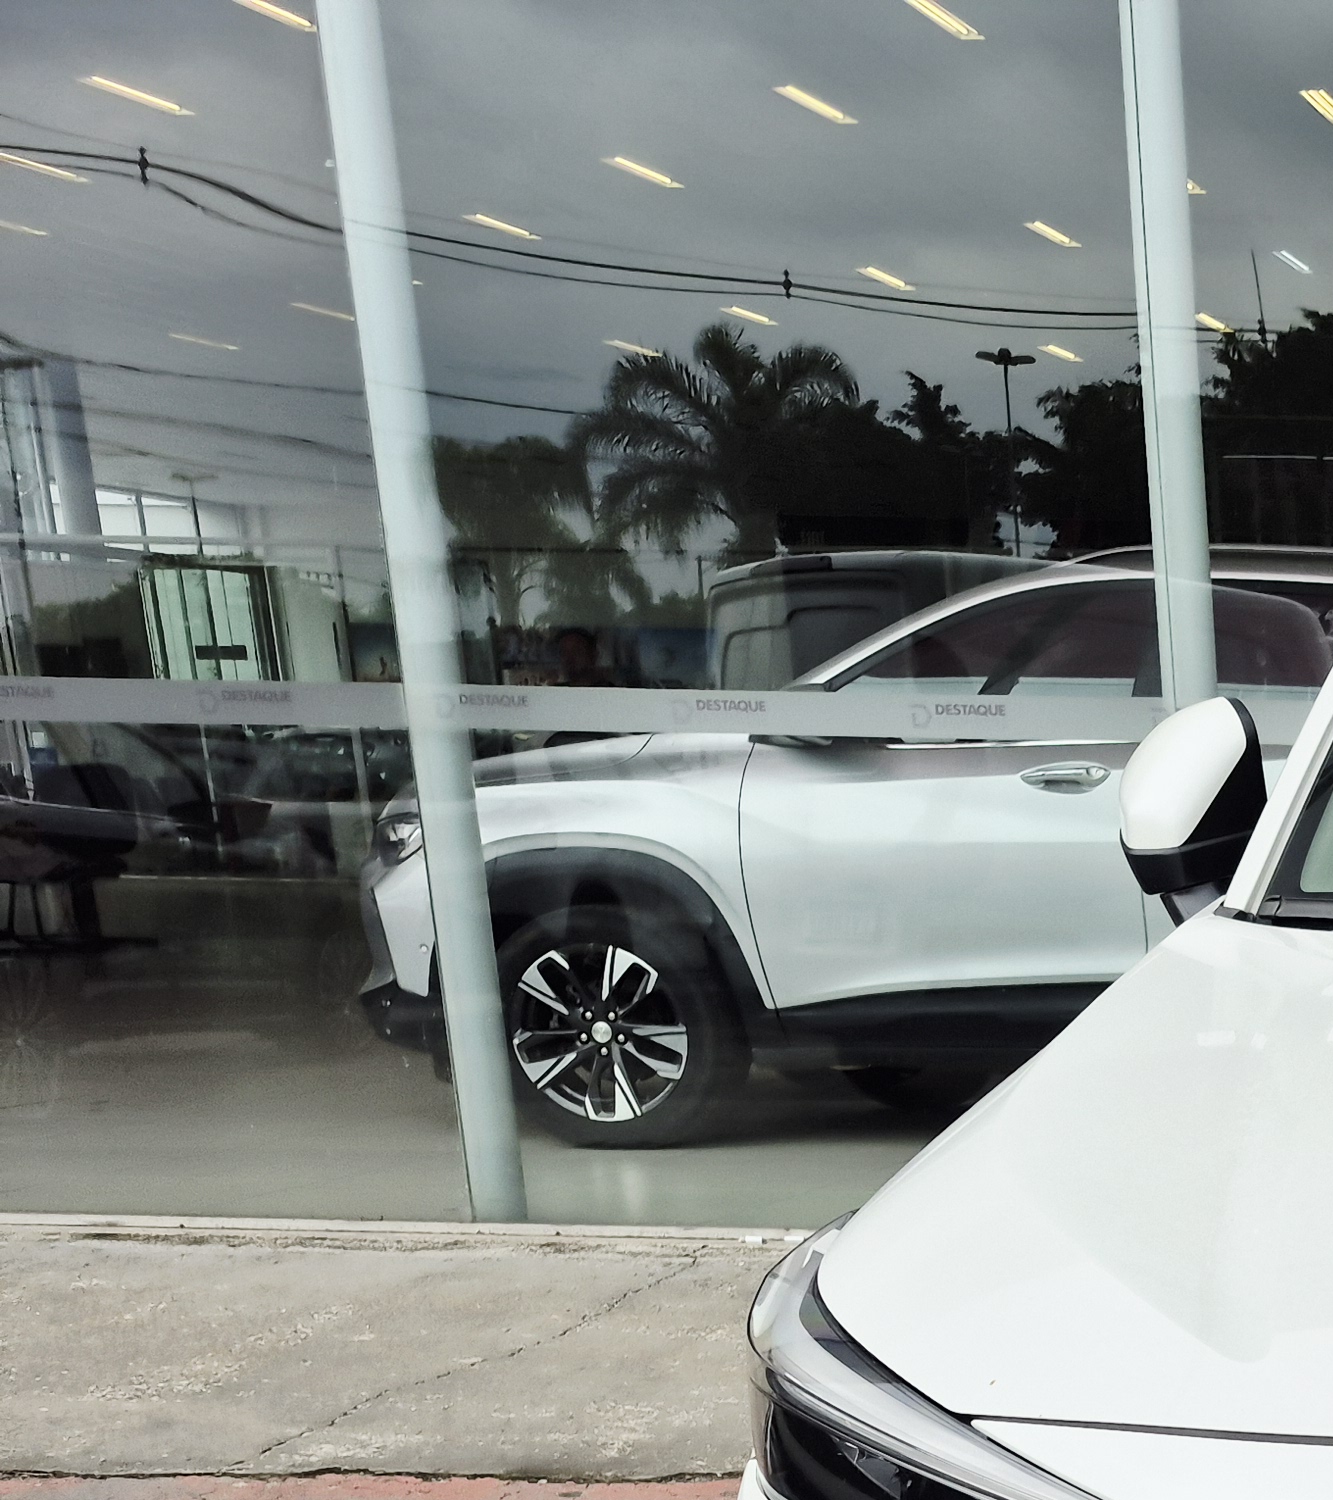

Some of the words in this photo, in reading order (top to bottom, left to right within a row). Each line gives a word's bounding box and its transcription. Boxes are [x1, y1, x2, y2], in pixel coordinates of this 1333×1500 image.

[221, 690, 292, 702] DESTAQUE
[459, 693, 529, 708] DESTAQUE
[696, 699, 767, 713] DESTAQUE
[935, 704, 1006, 717] DESTAQUE
